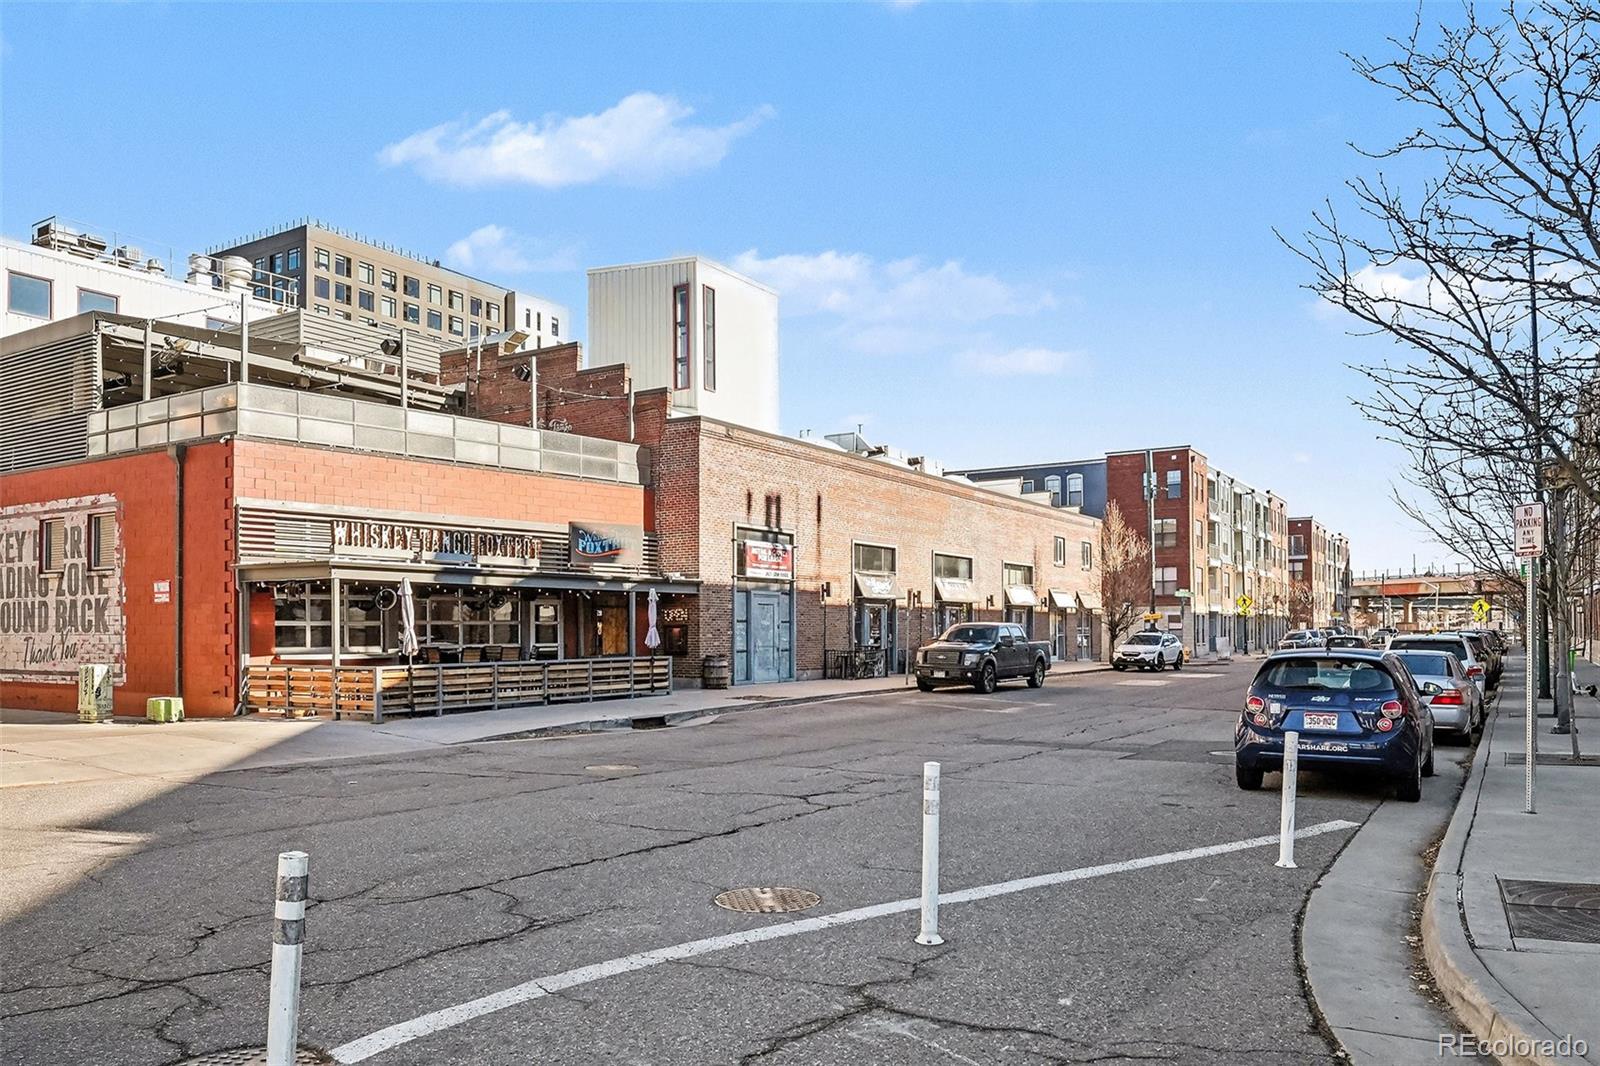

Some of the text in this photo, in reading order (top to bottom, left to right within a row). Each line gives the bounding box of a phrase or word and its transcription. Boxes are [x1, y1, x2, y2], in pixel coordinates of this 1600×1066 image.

[1516, 517, 1542, 528] PARKING
[1524, 507, 1533, 516] NO
[0, 530, 27, 563] EY
[332, 520, 542, 560] WHISKEY TANGO FOXTROT
[1522, 537, 1535, 545] TIME
[0, 562, 109, 599] DING ZONE
[55, 597, 110, 634] BACK
[24, 628, 79, 668] Thank You
[1296, 743, 1348, 753] ARSHARE.ORG
